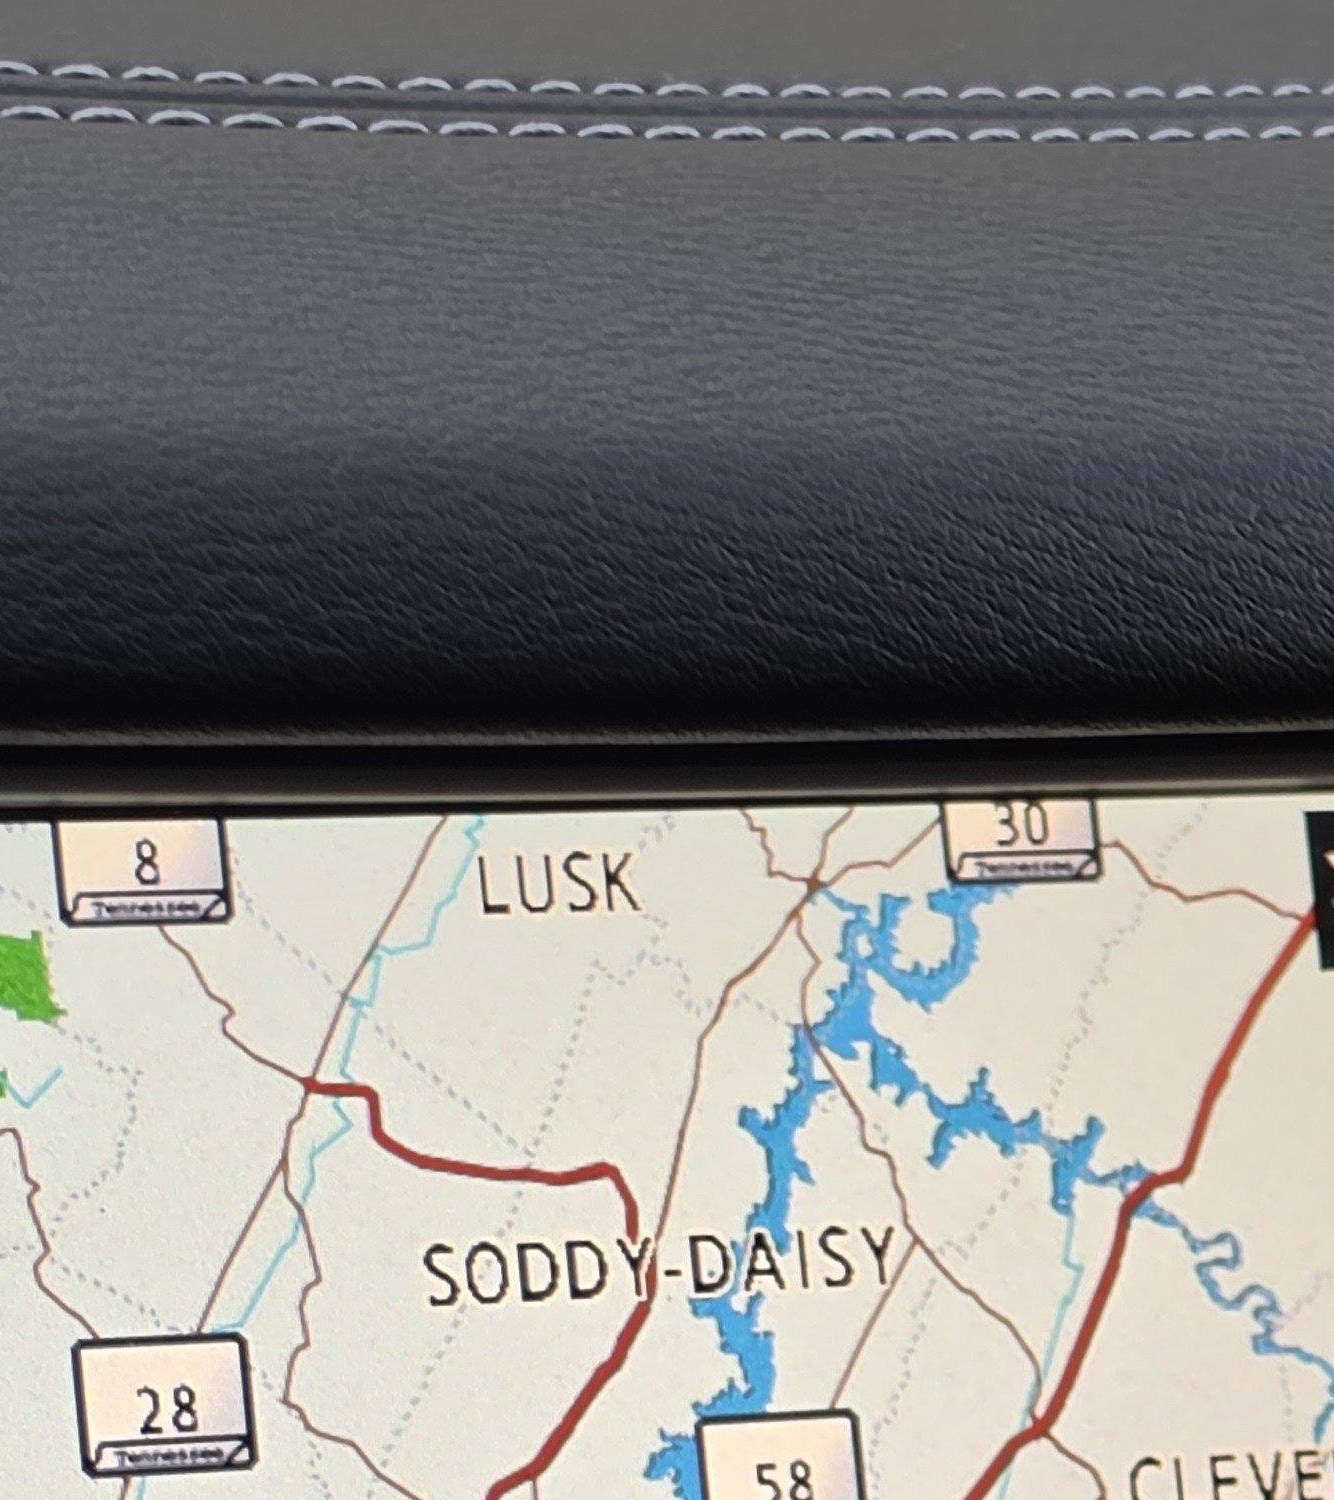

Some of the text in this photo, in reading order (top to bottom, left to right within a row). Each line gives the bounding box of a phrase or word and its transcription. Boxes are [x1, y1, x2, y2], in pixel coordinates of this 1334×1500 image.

[994, 800, 1049, 846] 30
[134, 838, 161, 886] 8
[478, 851, 641, 913] LUSK
[423, 1226, 894, 1306] SODDY-DAISY
[136, 1384, 199, 1435] 28
